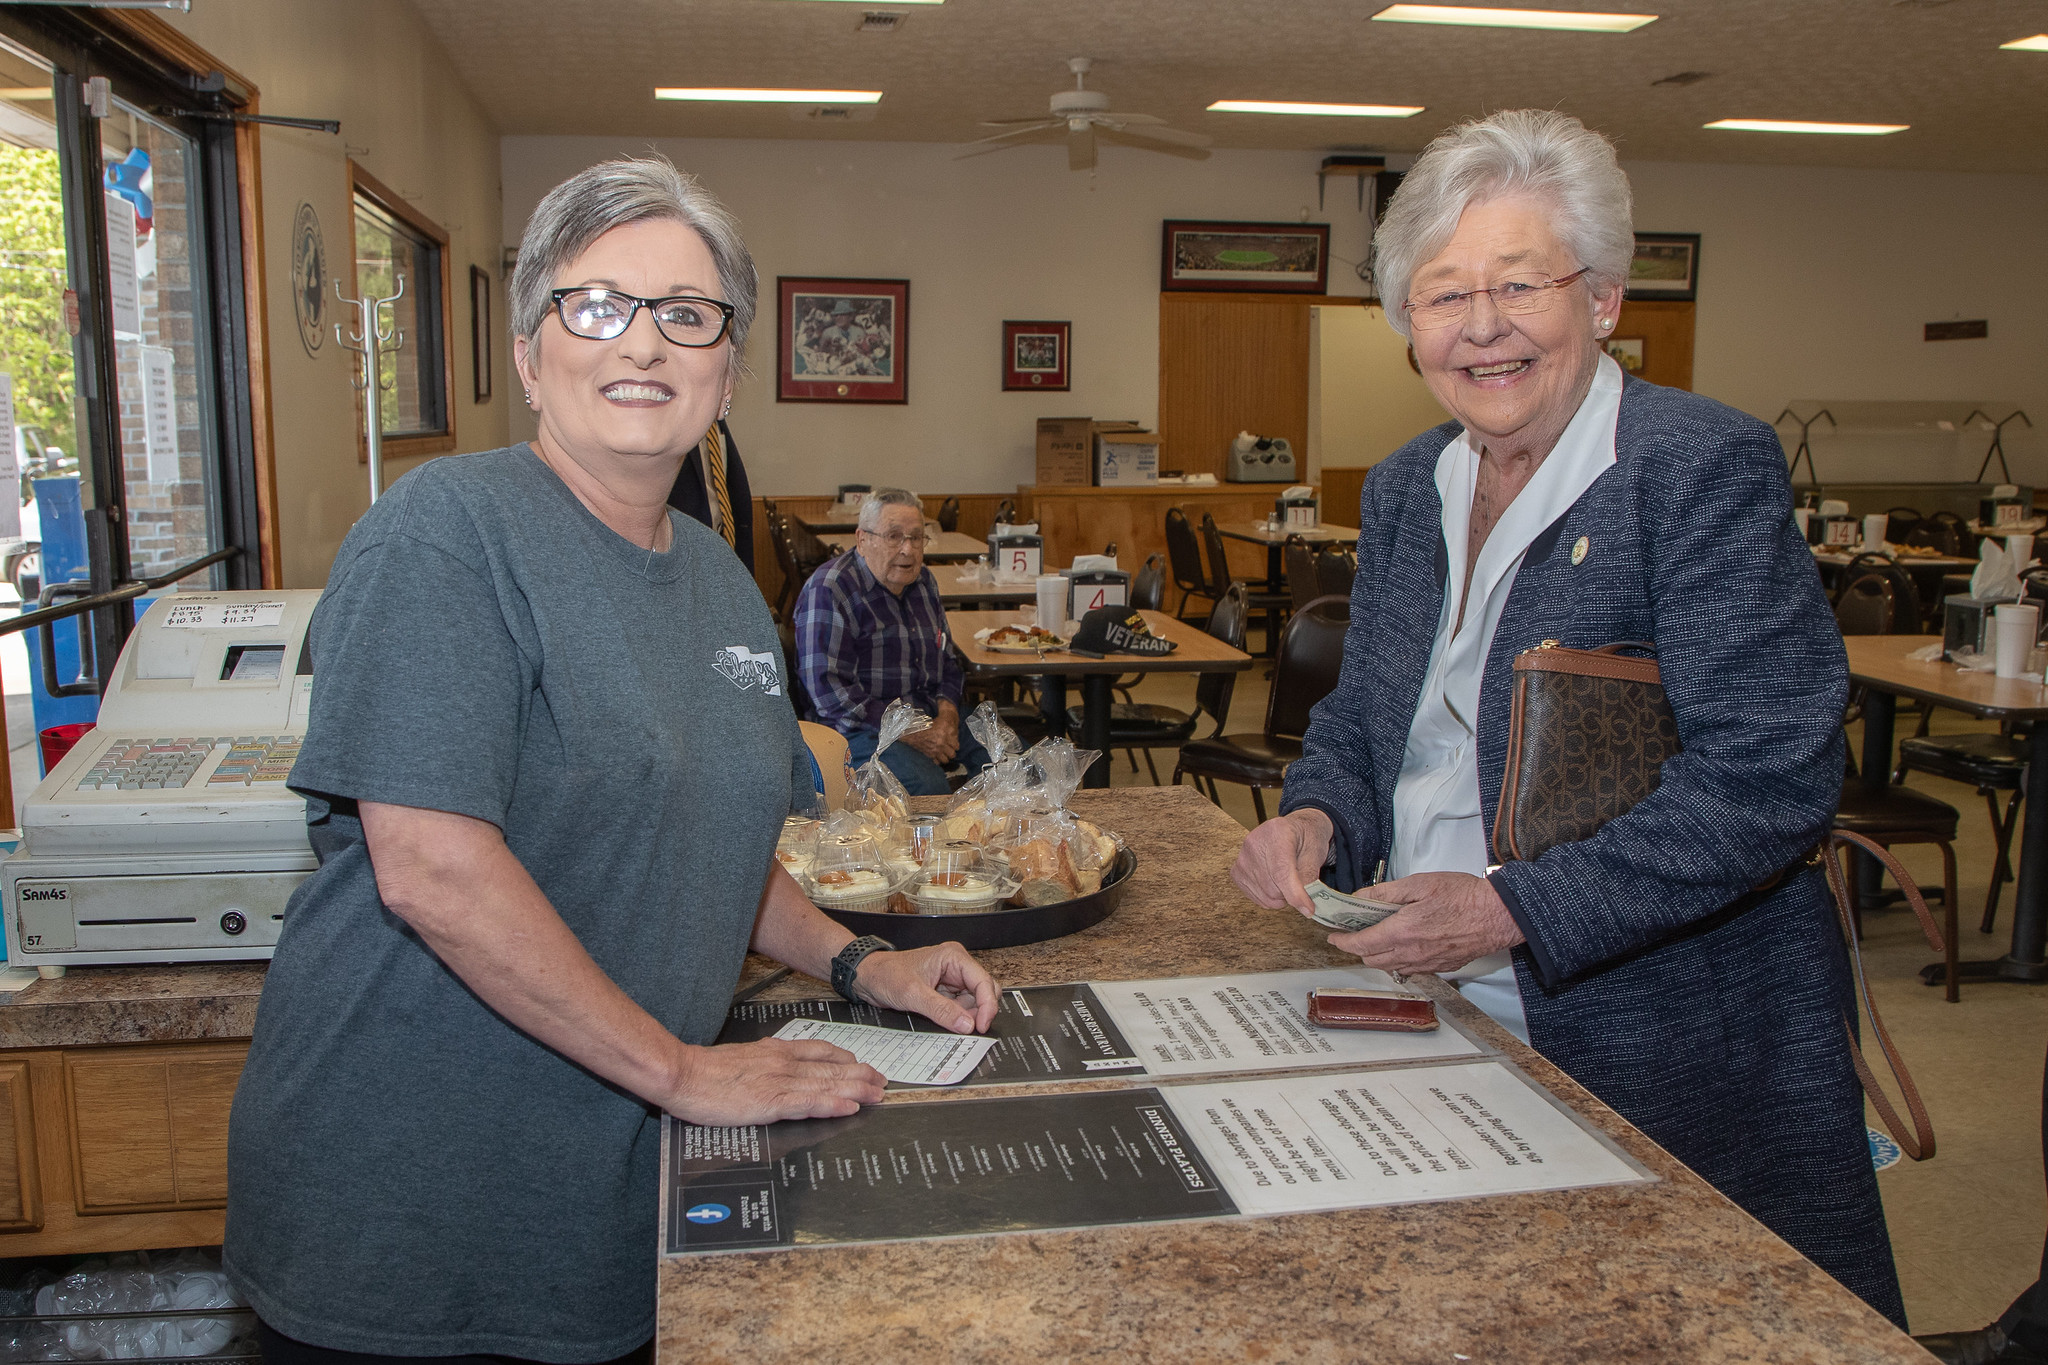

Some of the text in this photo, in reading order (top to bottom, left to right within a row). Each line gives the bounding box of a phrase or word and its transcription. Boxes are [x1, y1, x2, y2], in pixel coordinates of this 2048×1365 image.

[1294, 509, 1307, 526] 11
[2001, 508, 2018, 521] 19
[1833, 524, 1849, 543] 14
[1012, 551, 1027, 572] 5
[1089, 588, 1104, 610] 4
[167, 617, 203, 626] $10.33
[221, 616, 254, 624] $11.27
[1105, 622, 1171, 651] VETERAN
[22, 888, 67, 901] SAM4S
[27, 935, 42, 946] 57
[1152, 1044, 1175, 1062] Lunch:
[1254, 1038, 1277, 1055] Friday
[1455, 1093, 1483, 1109] cash!
[738, 1126, 748, 1146] uesday:
[1334, 1089, 1422, 1174] we will also be increasing
[1357, 1088, 1447, 1172] the price of certain menu
[1429, 1087, 1520, 1165] Reminder: you can save
[1487, 1117, 1522, 1140] paying
[720, 1127, 730, 1149] hursday:
[1205, 1108, 1271, 1186] Due to shortages from
[1221, 1098, 1296, 1184] our grocer companies we
[1253, 1108, 1321, 1182] might be out of some
[1318, 1098, 1397, 1176] Due to these shortages
[1513, 1142, 1530, 1151] by
[751, 1140, 759, 1161] CLOSED
[1145, 1109, 1176, 1146] DINNER
[1169, 1147, 1204, 1187] PLATES
[1302, 1135, 1346, 1180] menu items.
[1443, 1147, 1471, 1170] items.
[1523, 1152, 1543, 1163] 4%
[740, 1196, 751, 1228] Facebook!
[751, 1202, 759, 1219] us on
[759, 1190, 772, 1231] Keep up with
